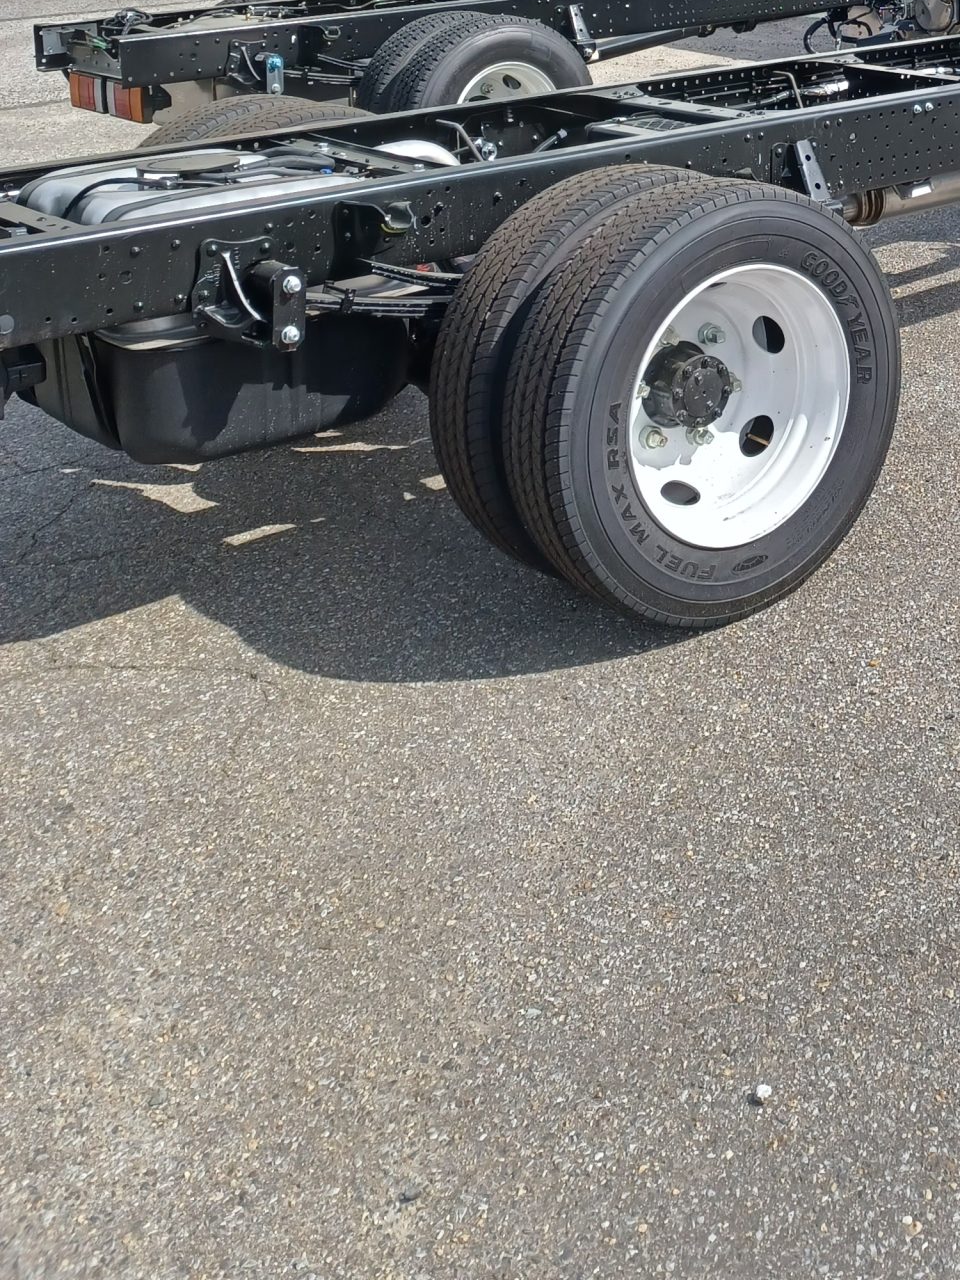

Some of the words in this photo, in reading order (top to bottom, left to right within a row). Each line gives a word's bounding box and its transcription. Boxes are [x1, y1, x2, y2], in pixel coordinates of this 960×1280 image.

[606, 402, 622, 471] RSA
[611, 483, 651, 546] MAX
[655, 544, 718, 580] FUEL
